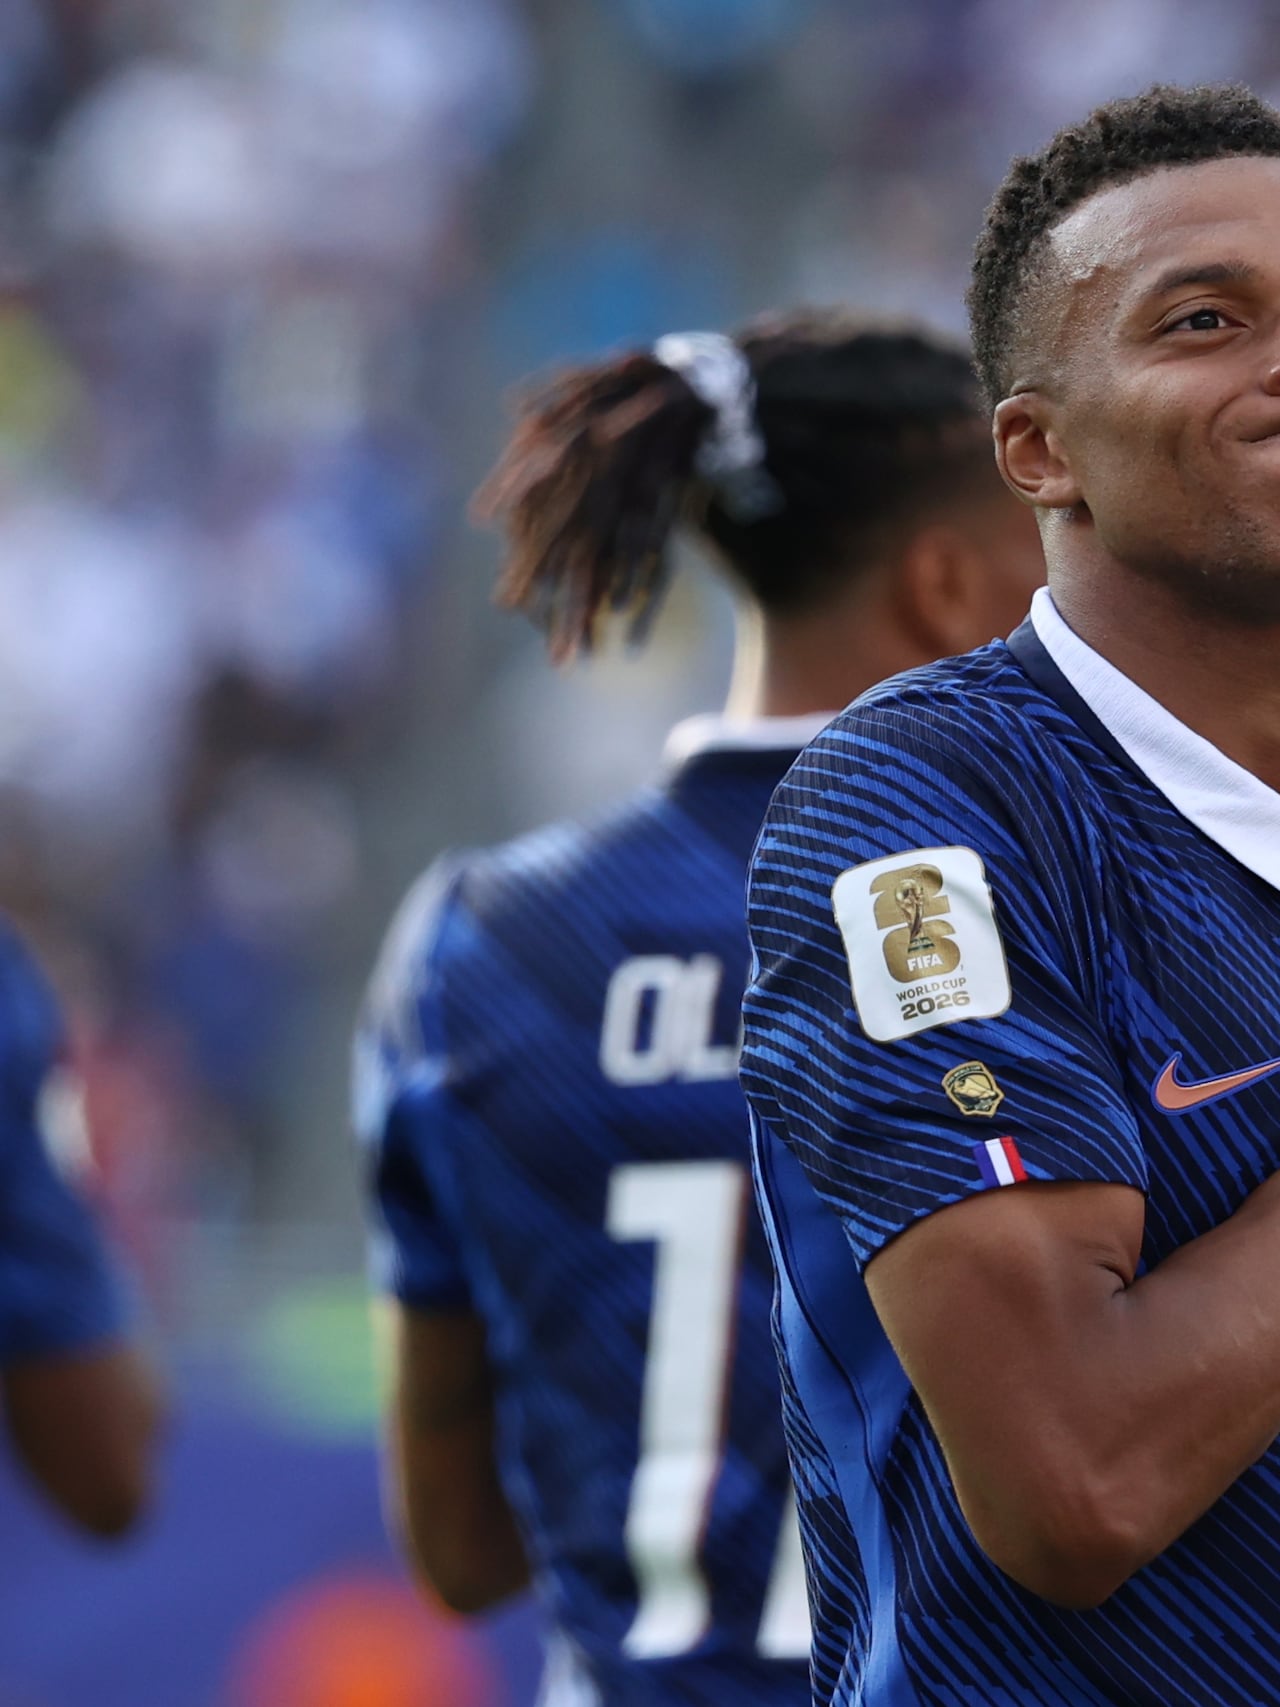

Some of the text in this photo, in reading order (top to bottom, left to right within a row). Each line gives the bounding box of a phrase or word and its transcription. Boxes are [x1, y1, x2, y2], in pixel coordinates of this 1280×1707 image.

[907, 953, 943, 972] FIFA
[896, 977, 967, 1001] WORLD CUP
[901, 990, 971, 1021] 2026
[600, 955, 745, 1086] OL
